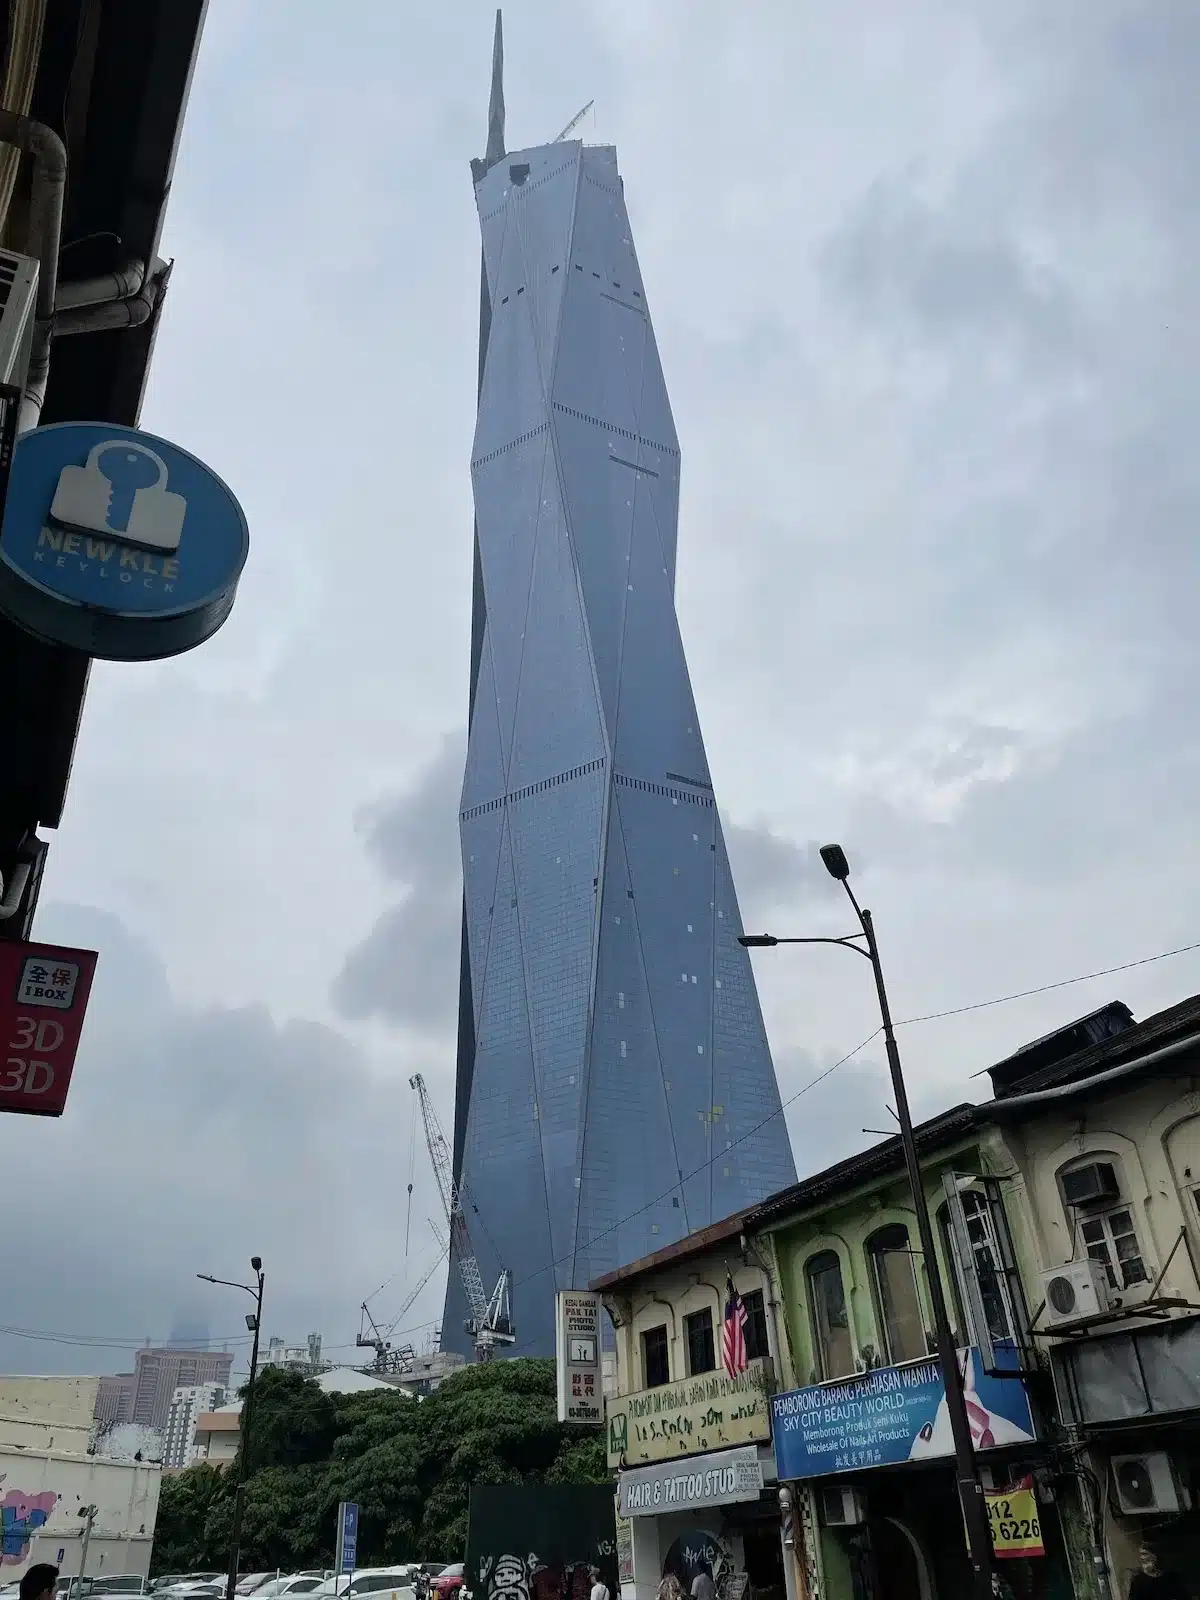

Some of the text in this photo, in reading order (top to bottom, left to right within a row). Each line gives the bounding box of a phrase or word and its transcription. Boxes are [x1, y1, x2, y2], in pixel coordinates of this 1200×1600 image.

[38, 525, 181, 580] NEWKLE
[34, 552, 175, 593] KEYLOCK
[27, 965, 72, 986] 全保
[33, 987, 68, 1000] BOX
[9, 1017, 64, 1052] 3D
[566, 1308, 581, 1316] PAK
[773, 1390, 820, 1417] PEMBORONG
[821, 1384, 855, 1408] BARANG
[855, 1371, 901, 1398] PERHIASAN
[902, 1364, 940, 1388] WANITA
[783, 1415, 800, 1432] SKY
[801, 1411, 822, 1428] CITY
[825, 1403, 863, 1422] BEAUTY
[865, 1392, 905, 1414] WORLD
[803, 1424, 844, 1441] Memborong
[846, 1420, 872, 1434] Produk
[890, 1412, 909, 1425] Kuku
[806, 1427, 910, 1455] Wholesale Of Nails Art Products
[627, 1482, 652, 1508] HAIR
[653, 1480, 662, 1505] &
[663, 1473, 704, 1503] TATTOO
[1000, 1519, 1040, 1541] 6226
